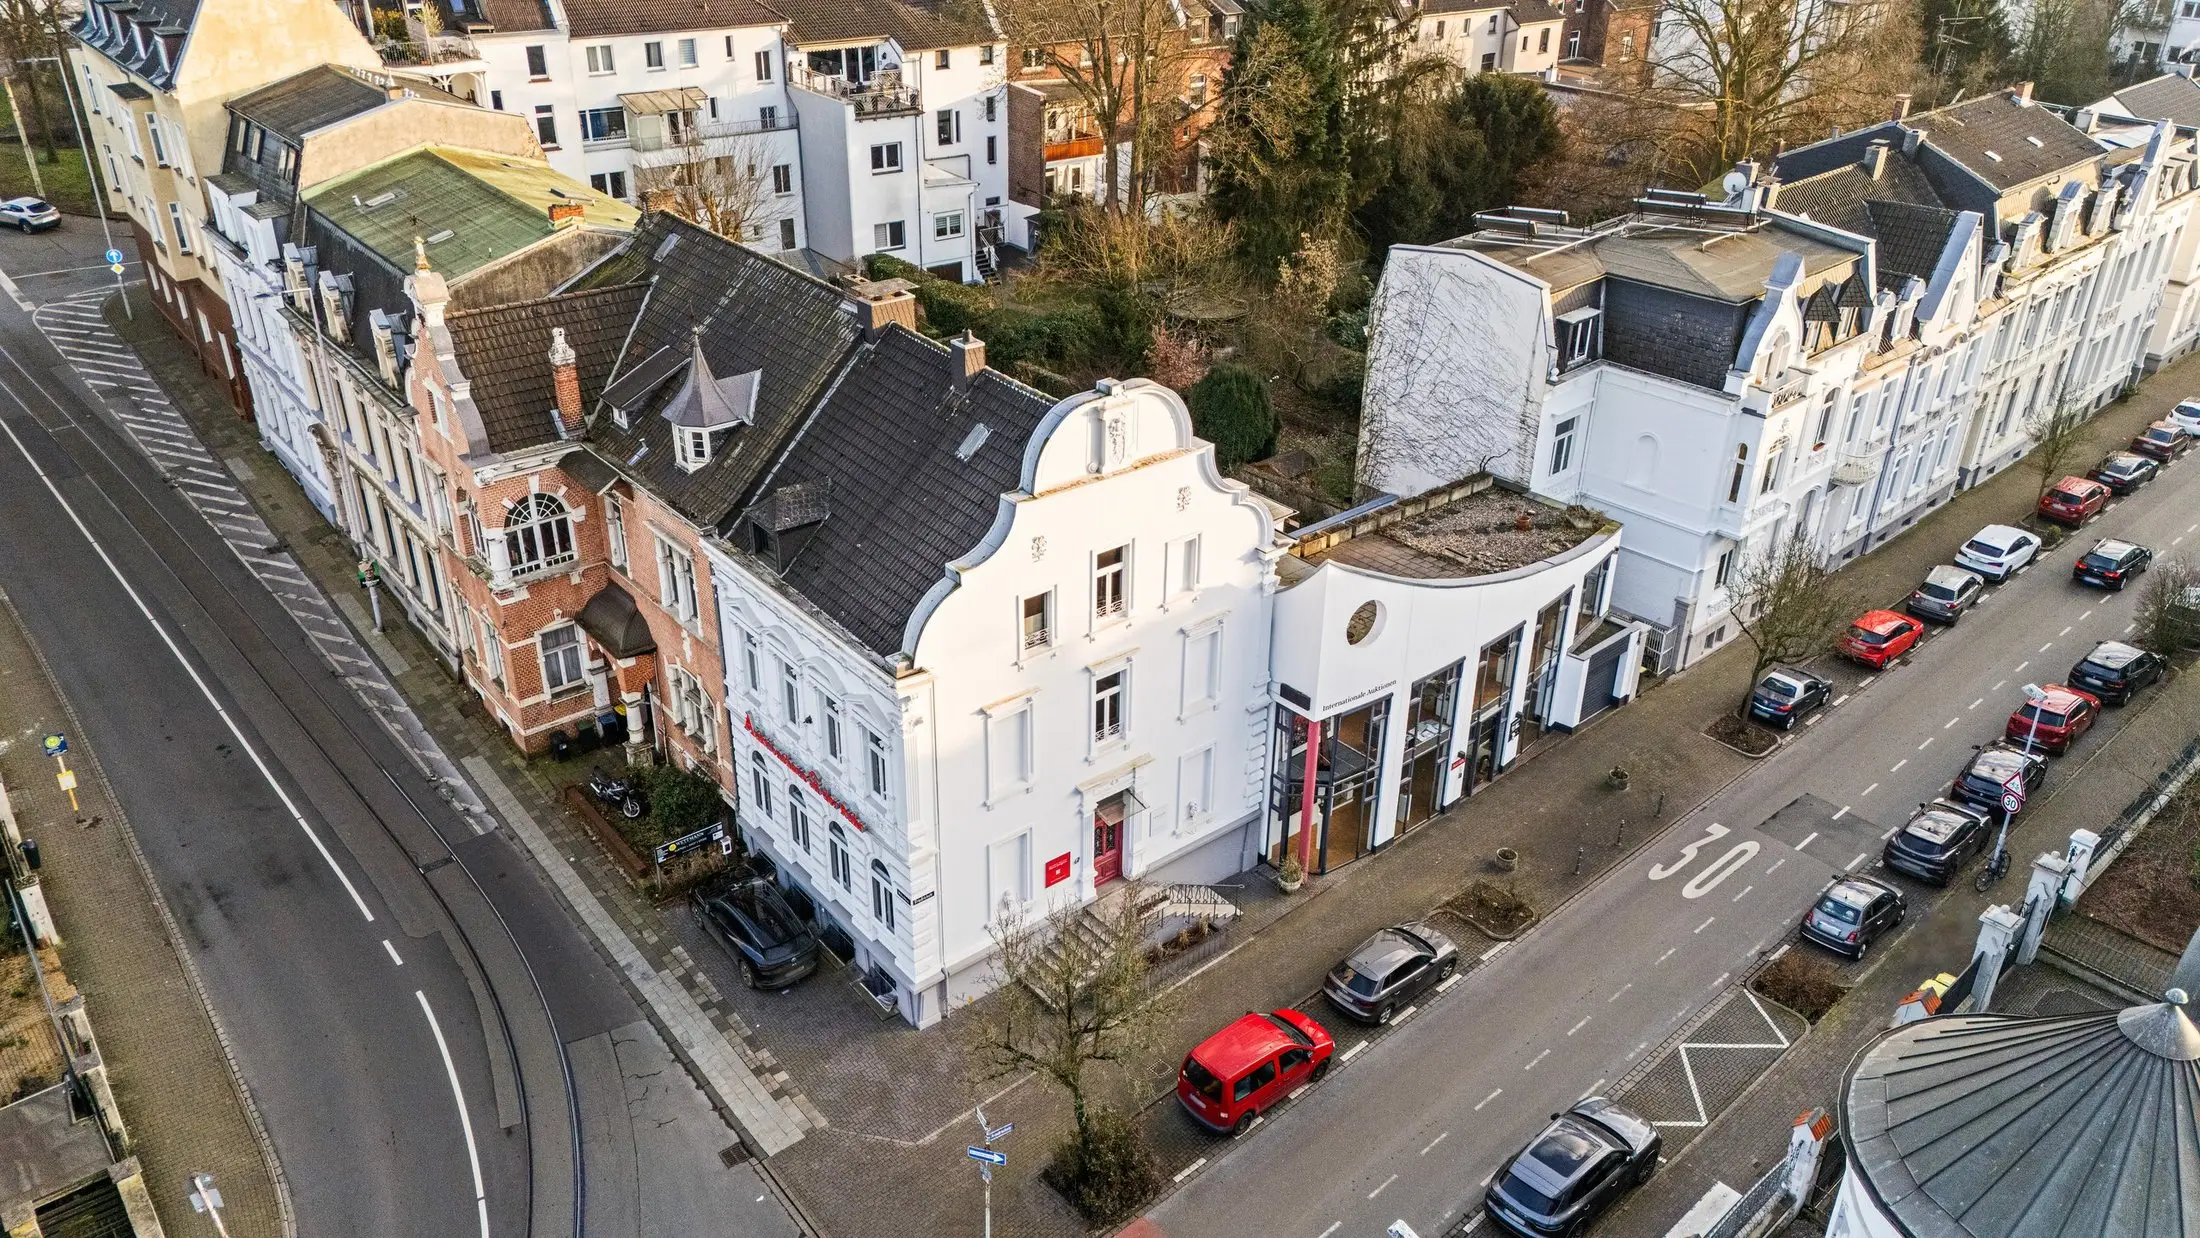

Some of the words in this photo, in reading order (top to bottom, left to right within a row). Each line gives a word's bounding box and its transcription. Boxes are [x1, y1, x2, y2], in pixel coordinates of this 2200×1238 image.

[1322, 691, 1366, 712] Internationale
[1366, 679, 1397, 697] Auktionen
[2005, 797, 2016, 809] 30
[1648, 822, 1761, 899] 30
